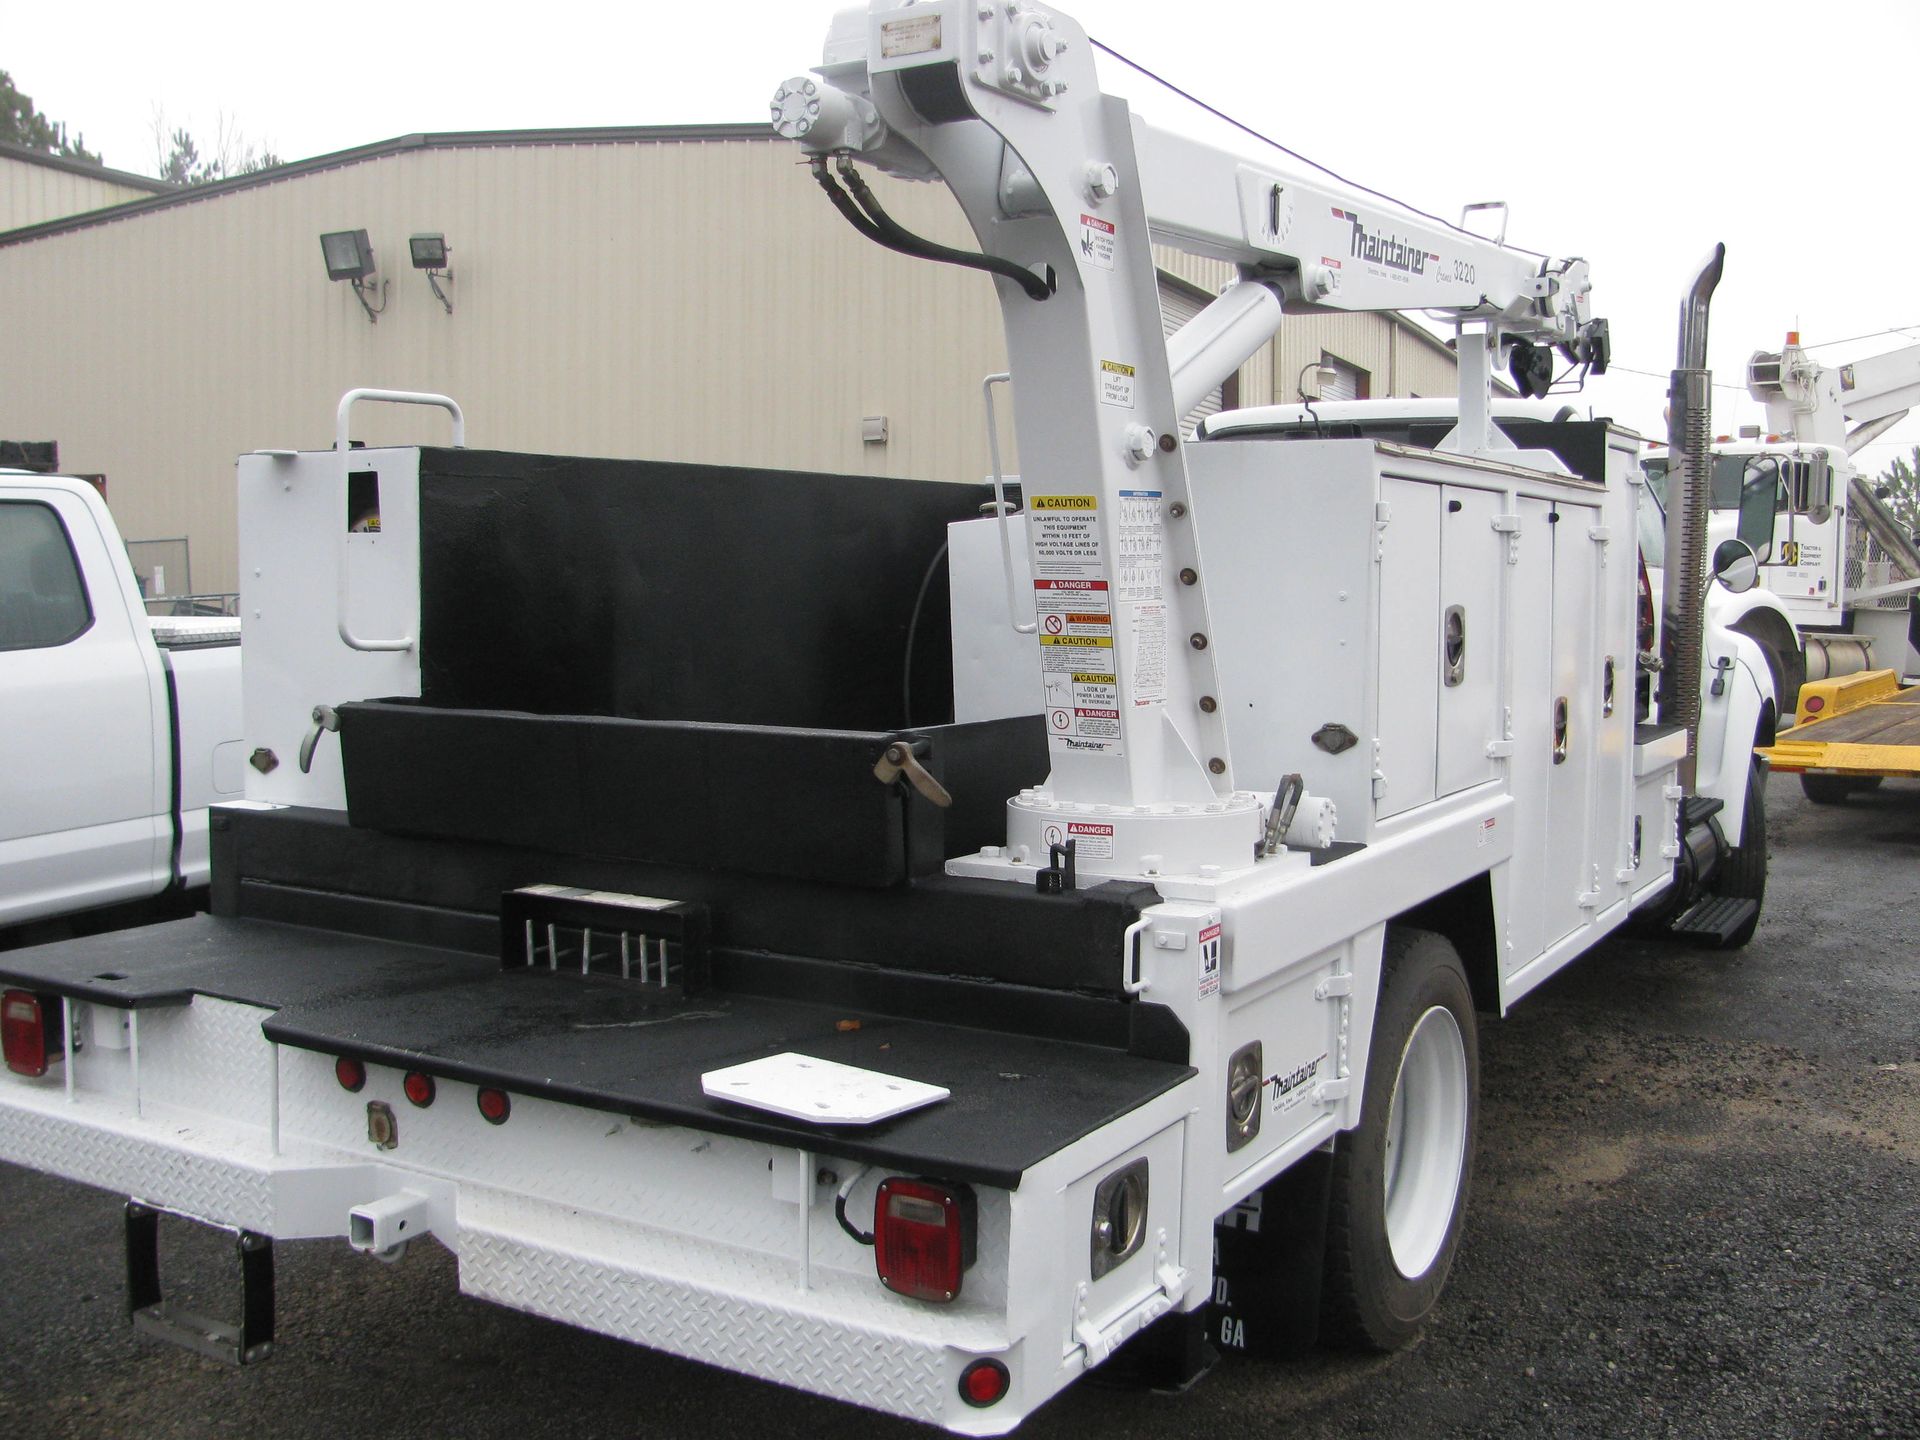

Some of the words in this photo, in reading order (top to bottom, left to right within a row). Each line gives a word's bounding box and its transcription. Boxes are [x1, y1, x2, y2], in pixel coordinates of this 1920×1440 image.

[1344, 210, 1430, 276] Maintainer
[1453, 259, 1475, 285] 3220
[1047, 498, 1090, 508] CAUTION
[1058, 581, 1092, 589] DANGER
[1075, 615, 1109, 623] WARNING
[1061, 637, 1098, 645] CAUTION
[1080, 675, 1114, 683] CAUTION
[1085, 709, 1117, 718] DANGER
[1077, 825, 1112, 834] DANGER
[1270, 1058, 1321, 1101] Maintainer
[1220, 1316, 1245, 1348] GA
